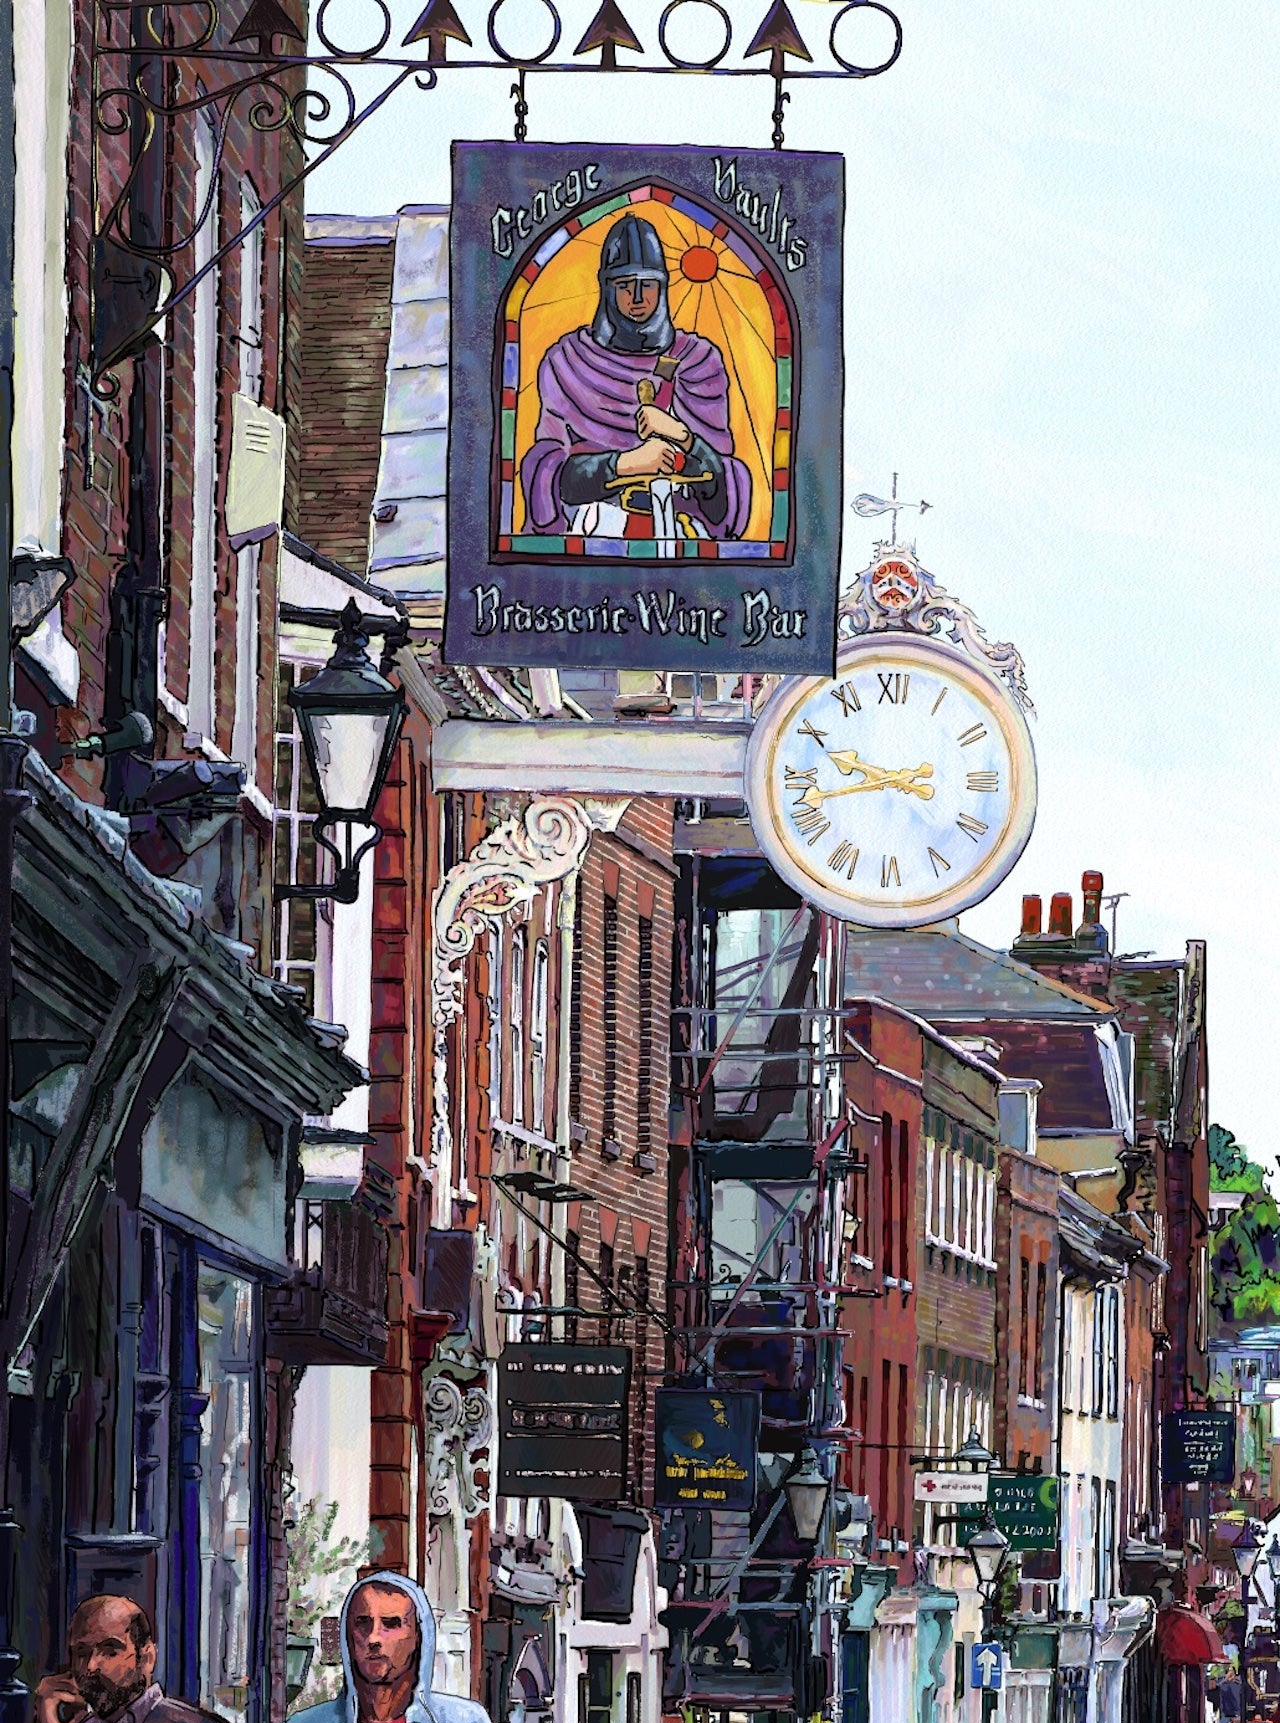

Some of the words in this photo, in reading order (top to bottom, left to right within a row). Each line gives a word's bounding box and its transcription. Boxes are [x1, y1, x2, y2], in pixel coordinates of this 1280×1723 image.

[490, 163, 602, 260] George
[711, 155, 809, 272] Vaults
[470, 584, 628, 637] Brasserie
[632, 589, 728, 645] Wine
[740, 588, 808, 648] Bar
[877, 673, 910, 705] XII
